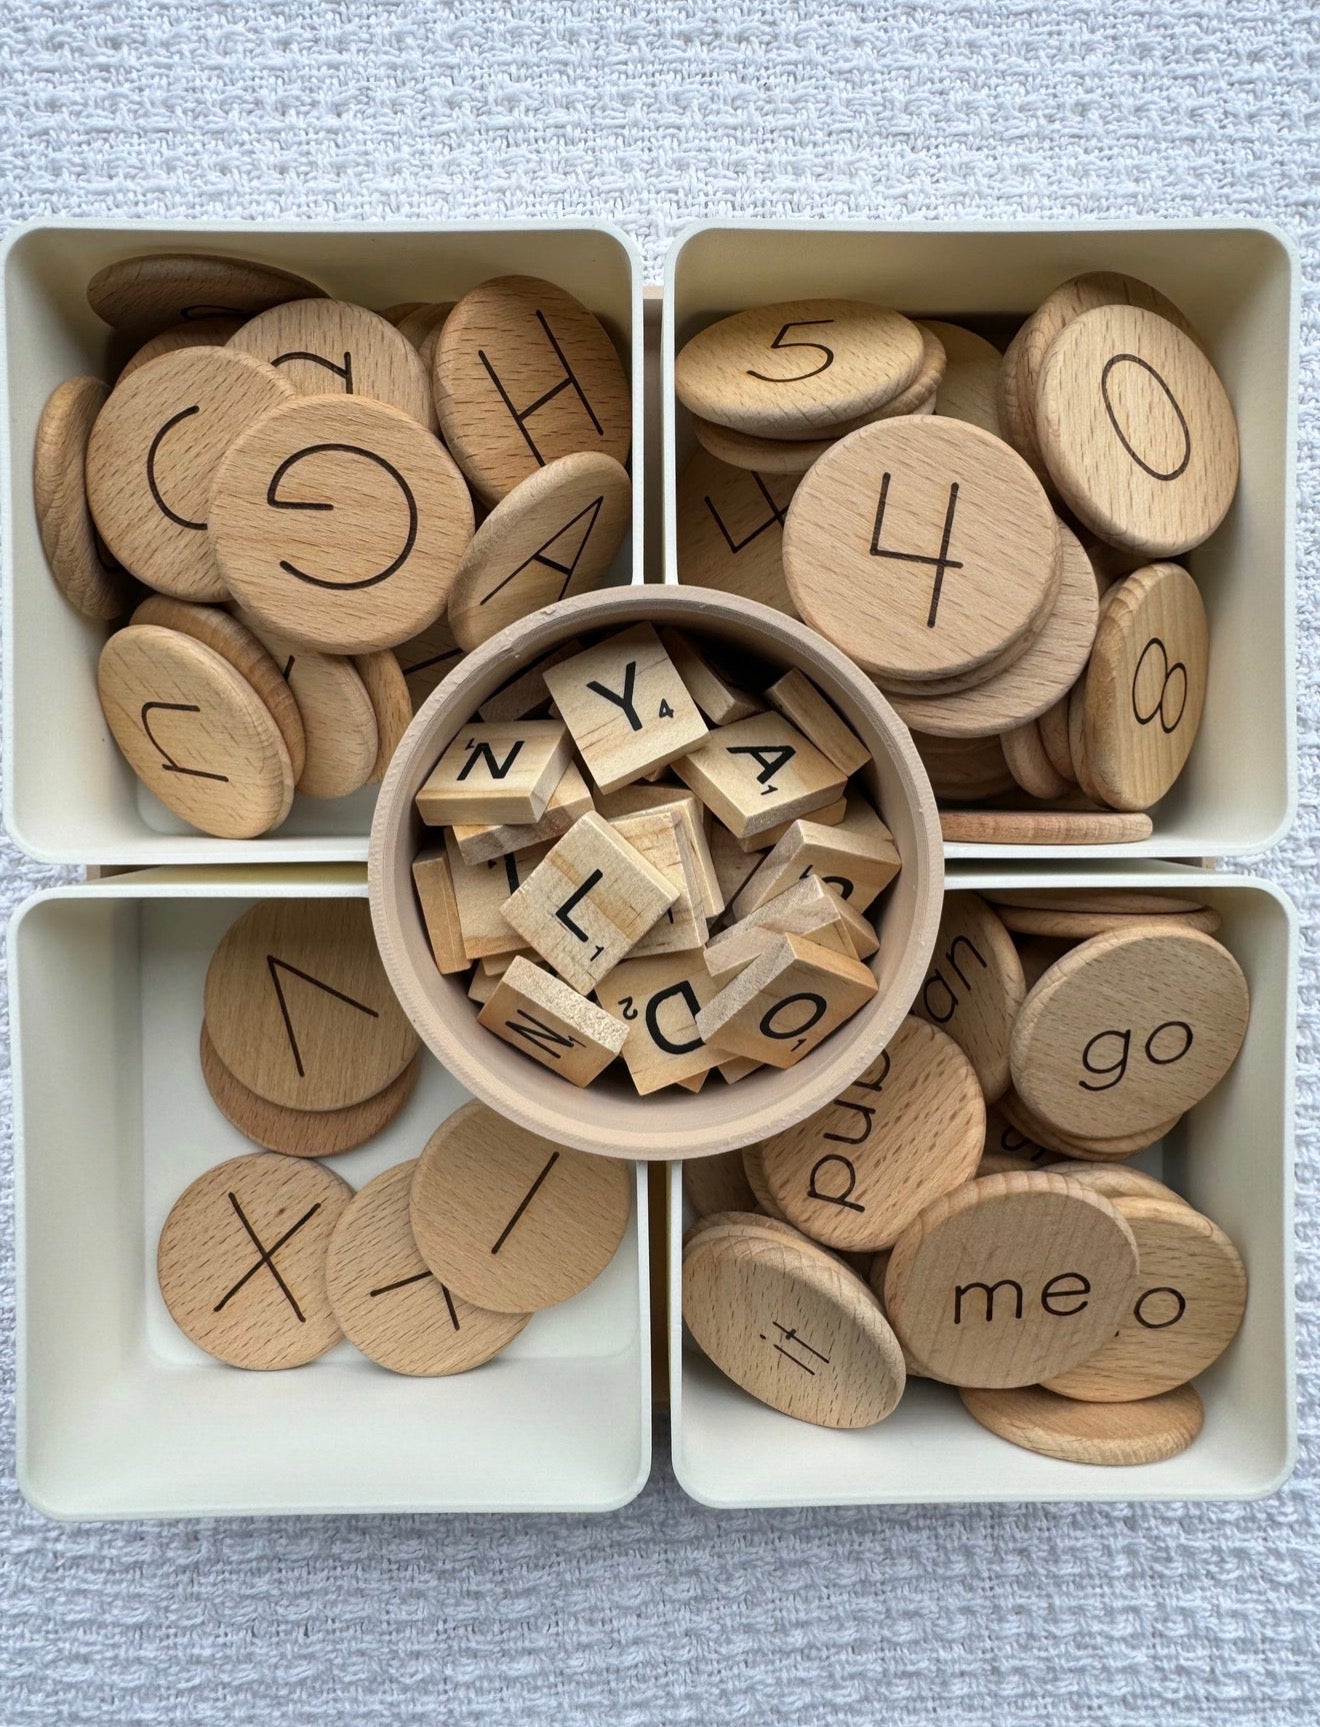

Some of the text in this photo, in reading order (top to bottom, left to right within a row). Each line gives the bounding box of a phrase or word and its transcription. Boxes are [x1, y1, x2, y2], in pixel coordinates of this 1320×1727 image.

[747, 319, 835, 383] 5
[478, 309, 605, 467] H
[266, 443, 419, 592] G
[480, 495, 605, 607] A
[869, 472, 964, 629] 4
[586, 660, 675, 732] Y 4
[1132, 637, 1188, 735] 8
[456, 740, 526, 782] N
[726, 744, 797, 797] A 1
[555, 868, 606, 962] L 1
[504, 1008, 576, 1060] N
[618, 979, 707, 1055] D 2
[790, 1037, 808, 1053] 1
[1079, 1021, 1194, 1092] go
[213, 1192, 322, 1324] X
[953, 1271, 1092, 1325] me
[759, 1319, 830, 1377] it
